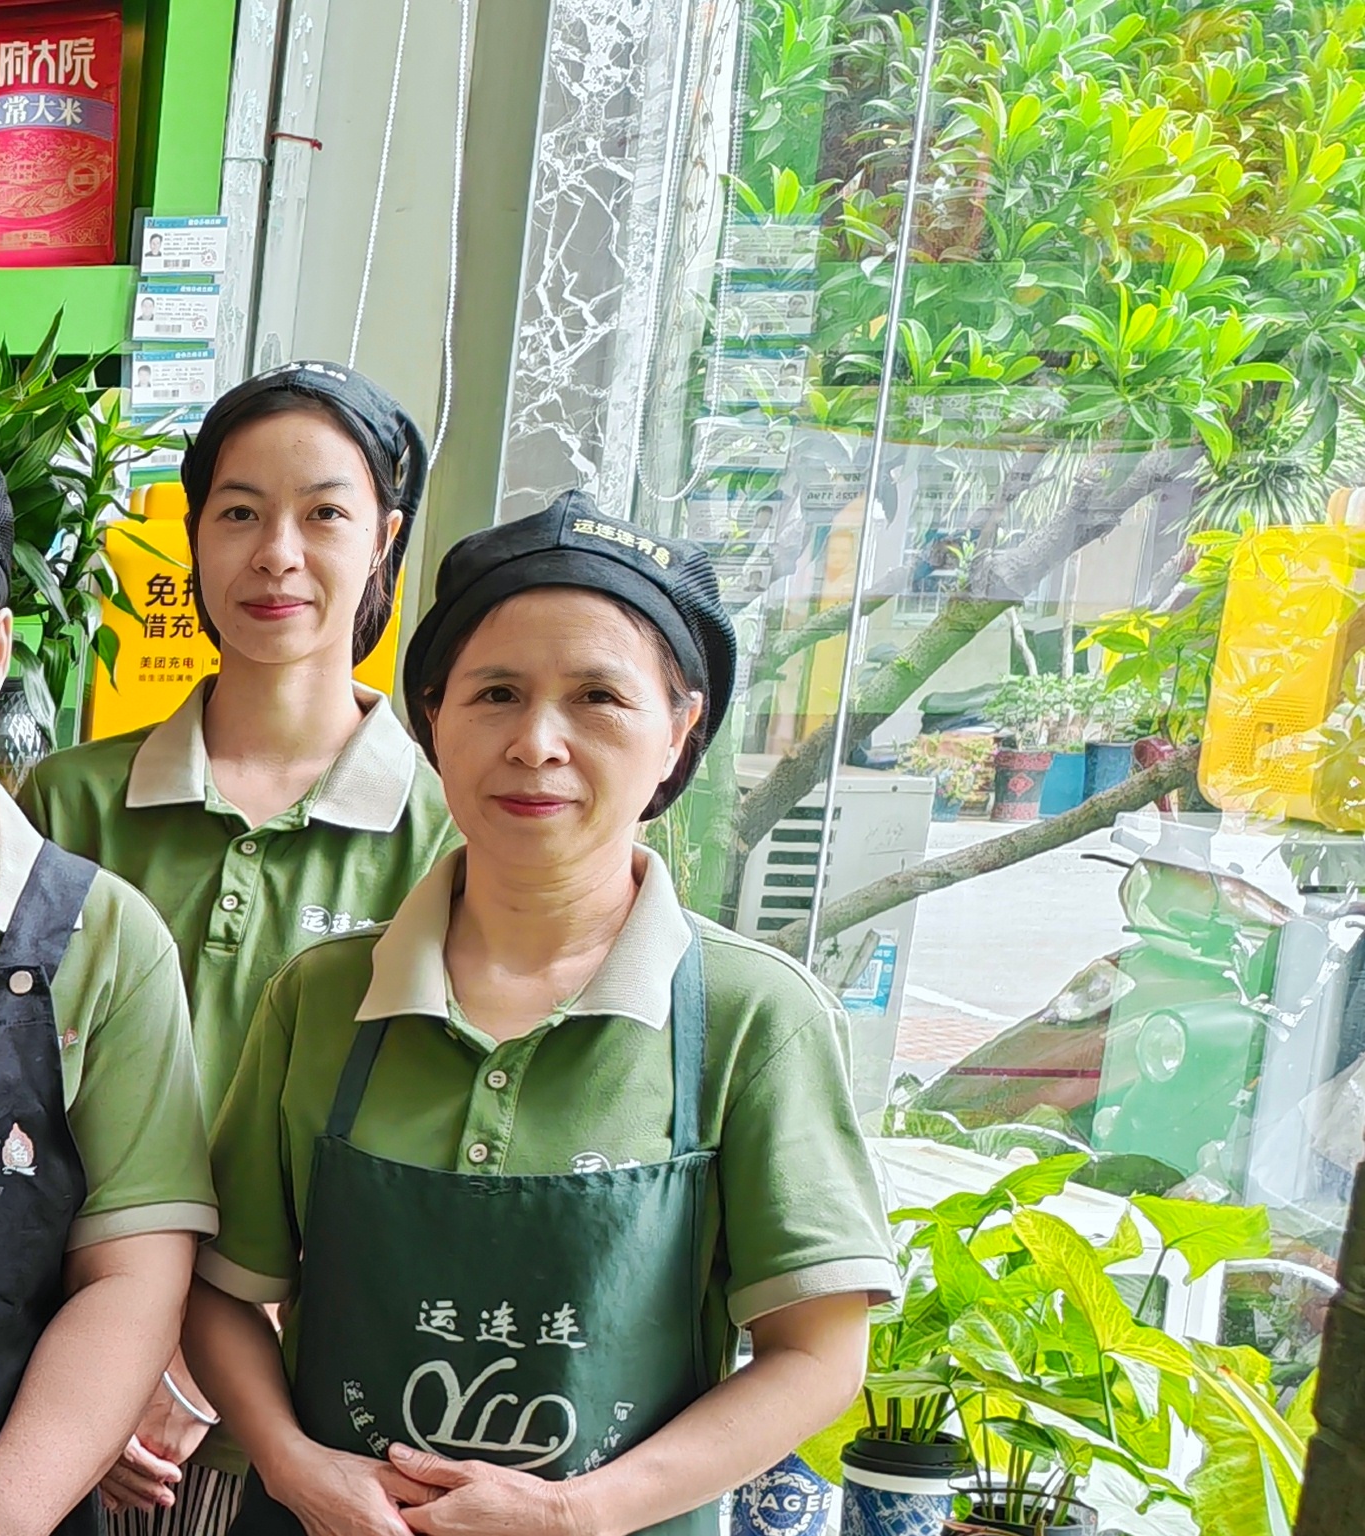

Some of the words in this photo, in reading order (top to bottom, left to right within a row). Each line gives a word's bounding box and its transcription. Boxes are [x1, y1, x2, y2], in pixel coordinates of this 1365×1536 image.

[572, 518, 671, 570] 运连连有鱼
[142, 613, 211, 639] 借充
[140, 656, 194, 669] 美团充电
[415, 1300, 587, 1349] 运连连
